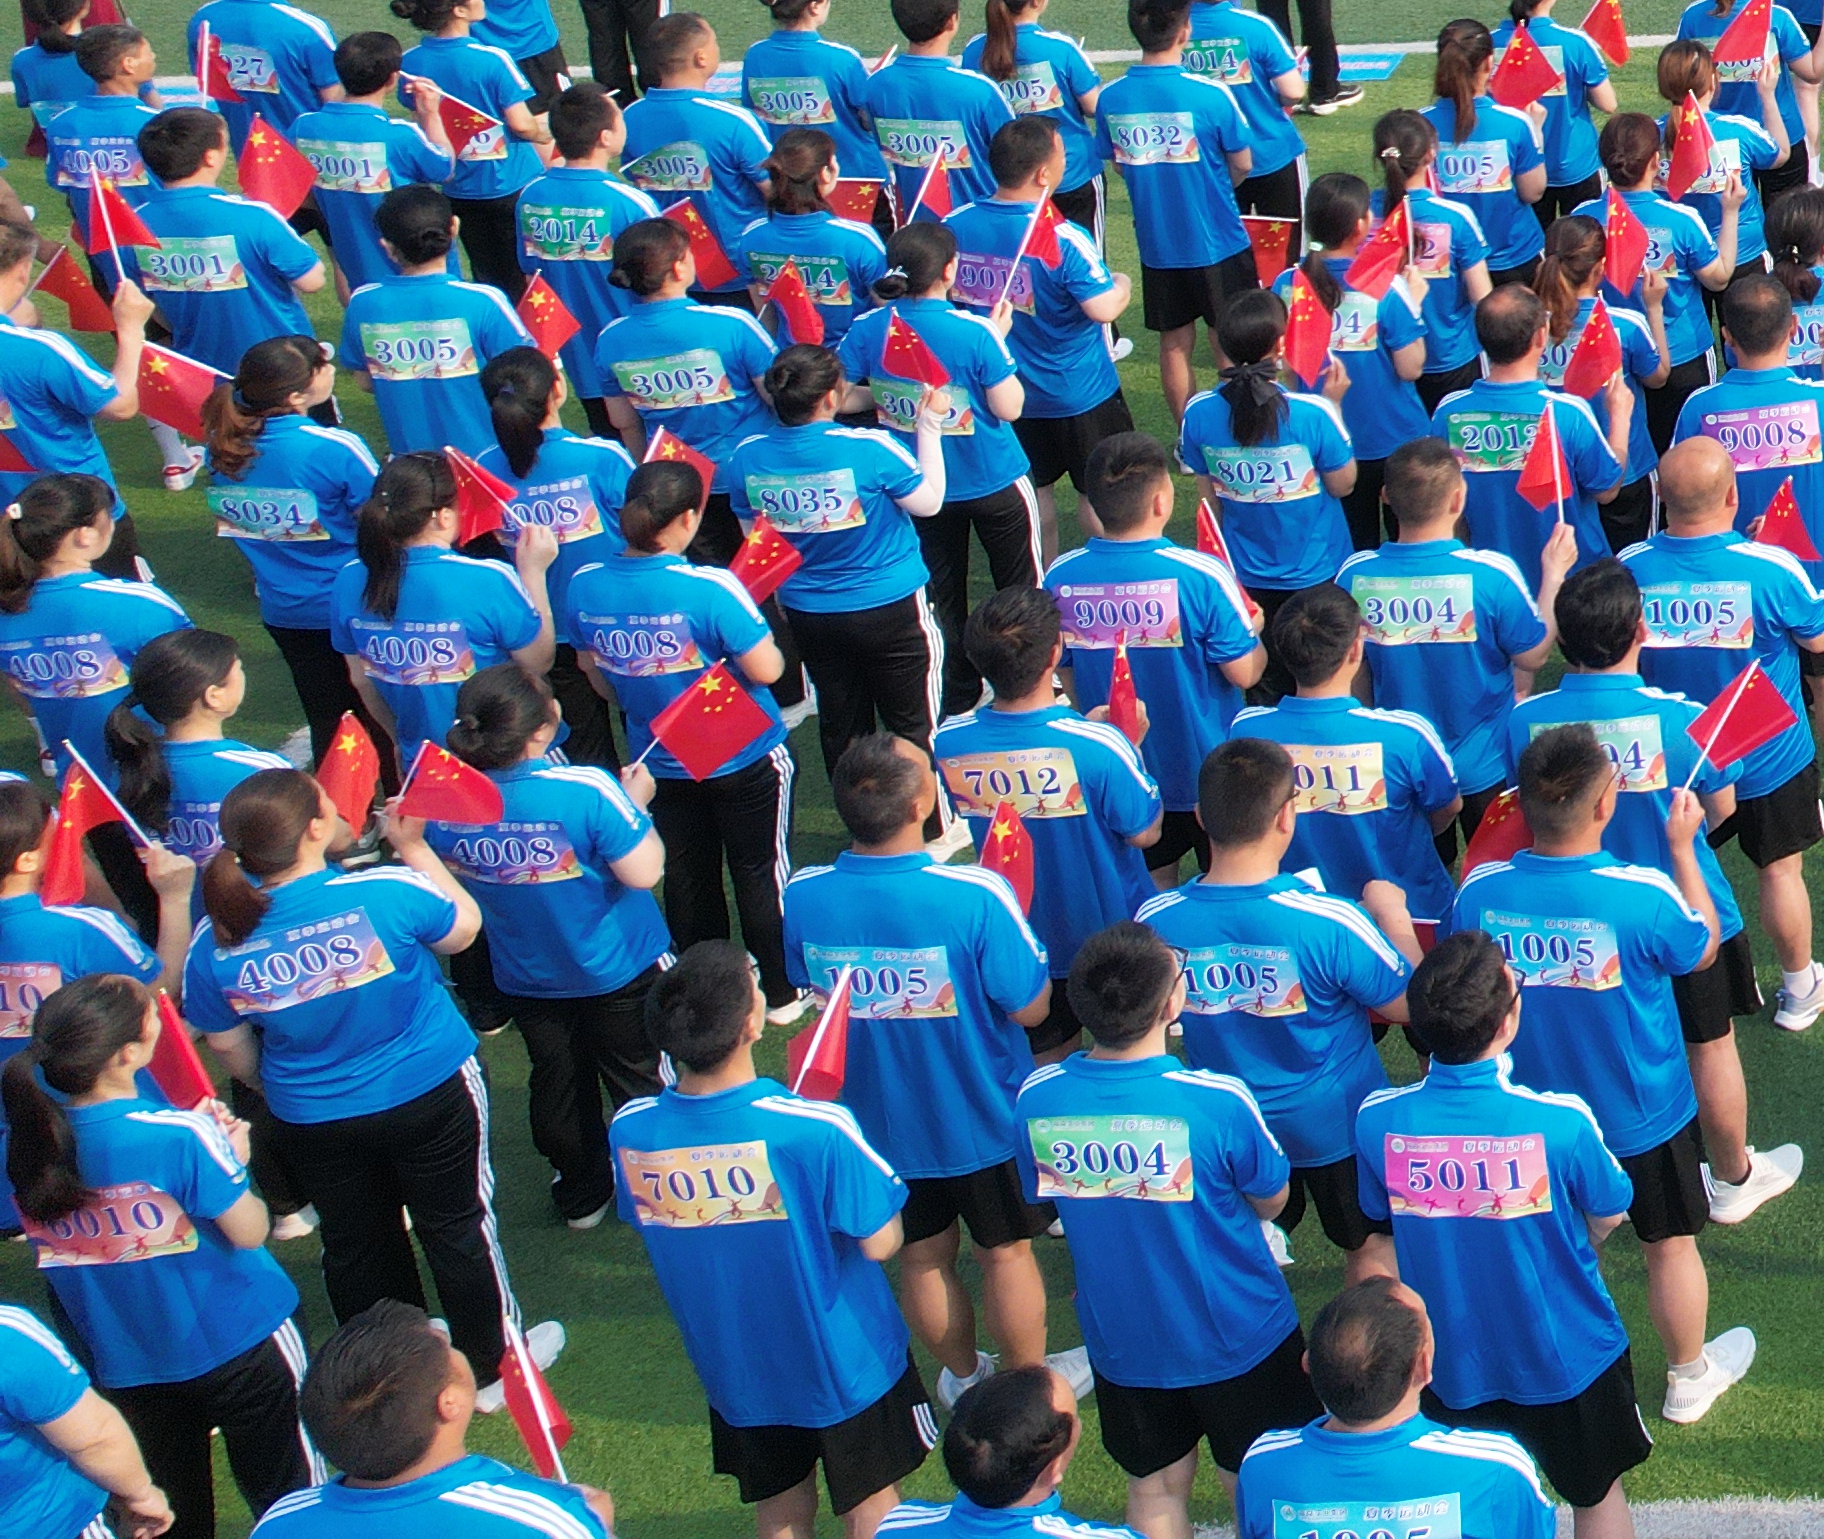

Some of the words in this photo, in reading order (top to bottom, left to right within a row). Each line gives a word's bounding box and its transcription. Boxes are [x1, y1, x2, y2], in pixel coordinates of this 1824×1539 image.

[1000, 76, 1045, 97] 005
[760, 91, 817, 113] 3005
[1117, 124, 1182, 149] 8032
[309, 153, 374, 179] 3001
[641, 154, 701, 179] 3005
[1444, 154, 1495, 177] 005
[529, 217, 598, 244] 2014
[150, 253, 223, 279] 3001
[761, 263, 834, 287] 214
[374, 337, 459, 365] 3005
[631, 366, 713, 392] 3005
[1720, 419, 1805, 449] 9008
[1219, 460, 1298, 485] 8021
[223, 500, 301, 525] 8034
[761, 485, 842, 513] 8035
[1074, 598, 1164, 627] 9009
[1366, 596, 1456, 625] 3004
[1648, 599, 1734, 627] 1005
[367, 638, 450, 665] 4008
[594, 632, 675, 657] 4008
[963, 768, 1061, 797] 7012
[1294, 764, 1361, 792] 011
[451, 838, 554, 867] 4008
[241, 935, 361, 990] 4008
[1502, 934, 1595, 964] 1005
[1186, 964, 1278, 994] 1005
[1052, 1141, 1170, 1178] 3004
[644, 1166, 756, 1203] 7010
[1407, 1158, 1527, 1192] 5011
